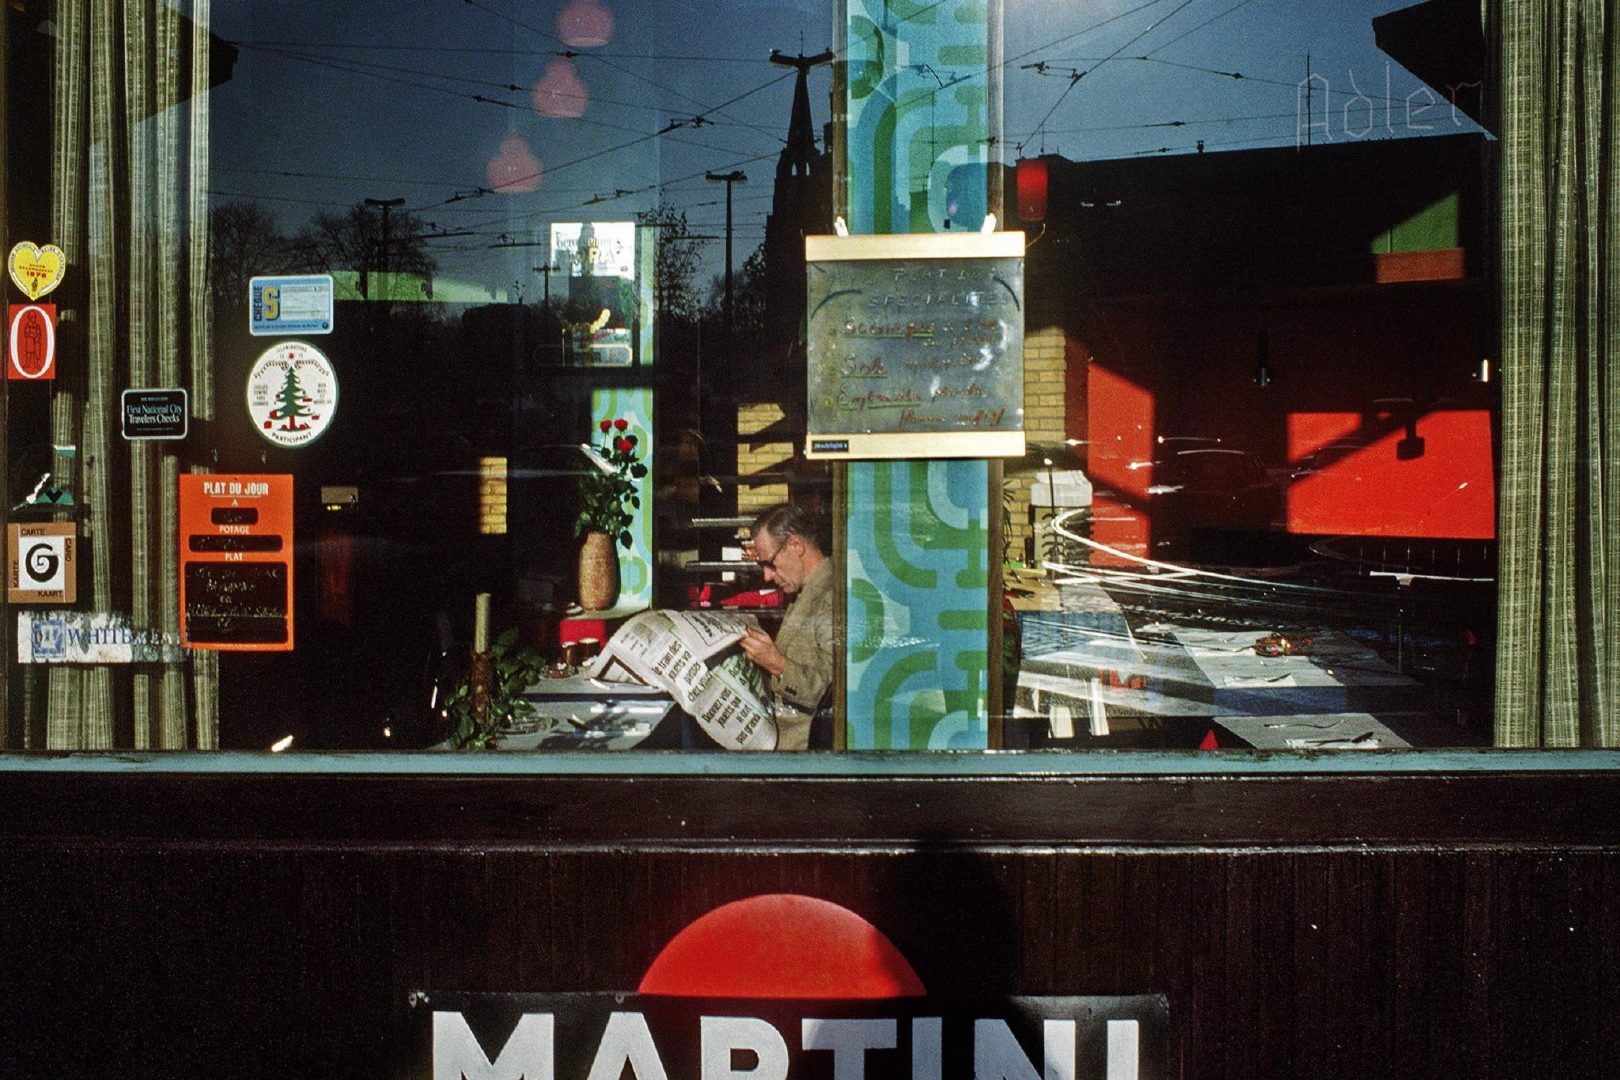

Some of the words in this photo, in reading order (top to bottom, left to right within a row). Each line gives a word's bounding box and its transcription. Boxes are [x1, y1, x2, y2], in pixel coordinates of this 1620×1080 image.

[253, 286, 263, 321] CHEQUE
[126, 405, 142, 414] First
[142, 404, 169, 414] National
[170, 404, 182, 416] City
[128, 415, 156, 425] Travelers
[156, 413, 180, 424] Checks
[271, 431, 313, 444] PARTICIPANT
[203, 482, 227, 495] PLAT
[229, 482, 242, 495] DU
[244, 482, 269, 496] JOUR
[20, 528, 46, 537] CARTE
[218, 525, 250, 535] POTAGE
[224, 552, 244, 562] PLAT
[12, 561, 20, 589] KARTE
[37, 589, 64, 598] KAART
[432, 1010, 1140, 1080] MARTINI
